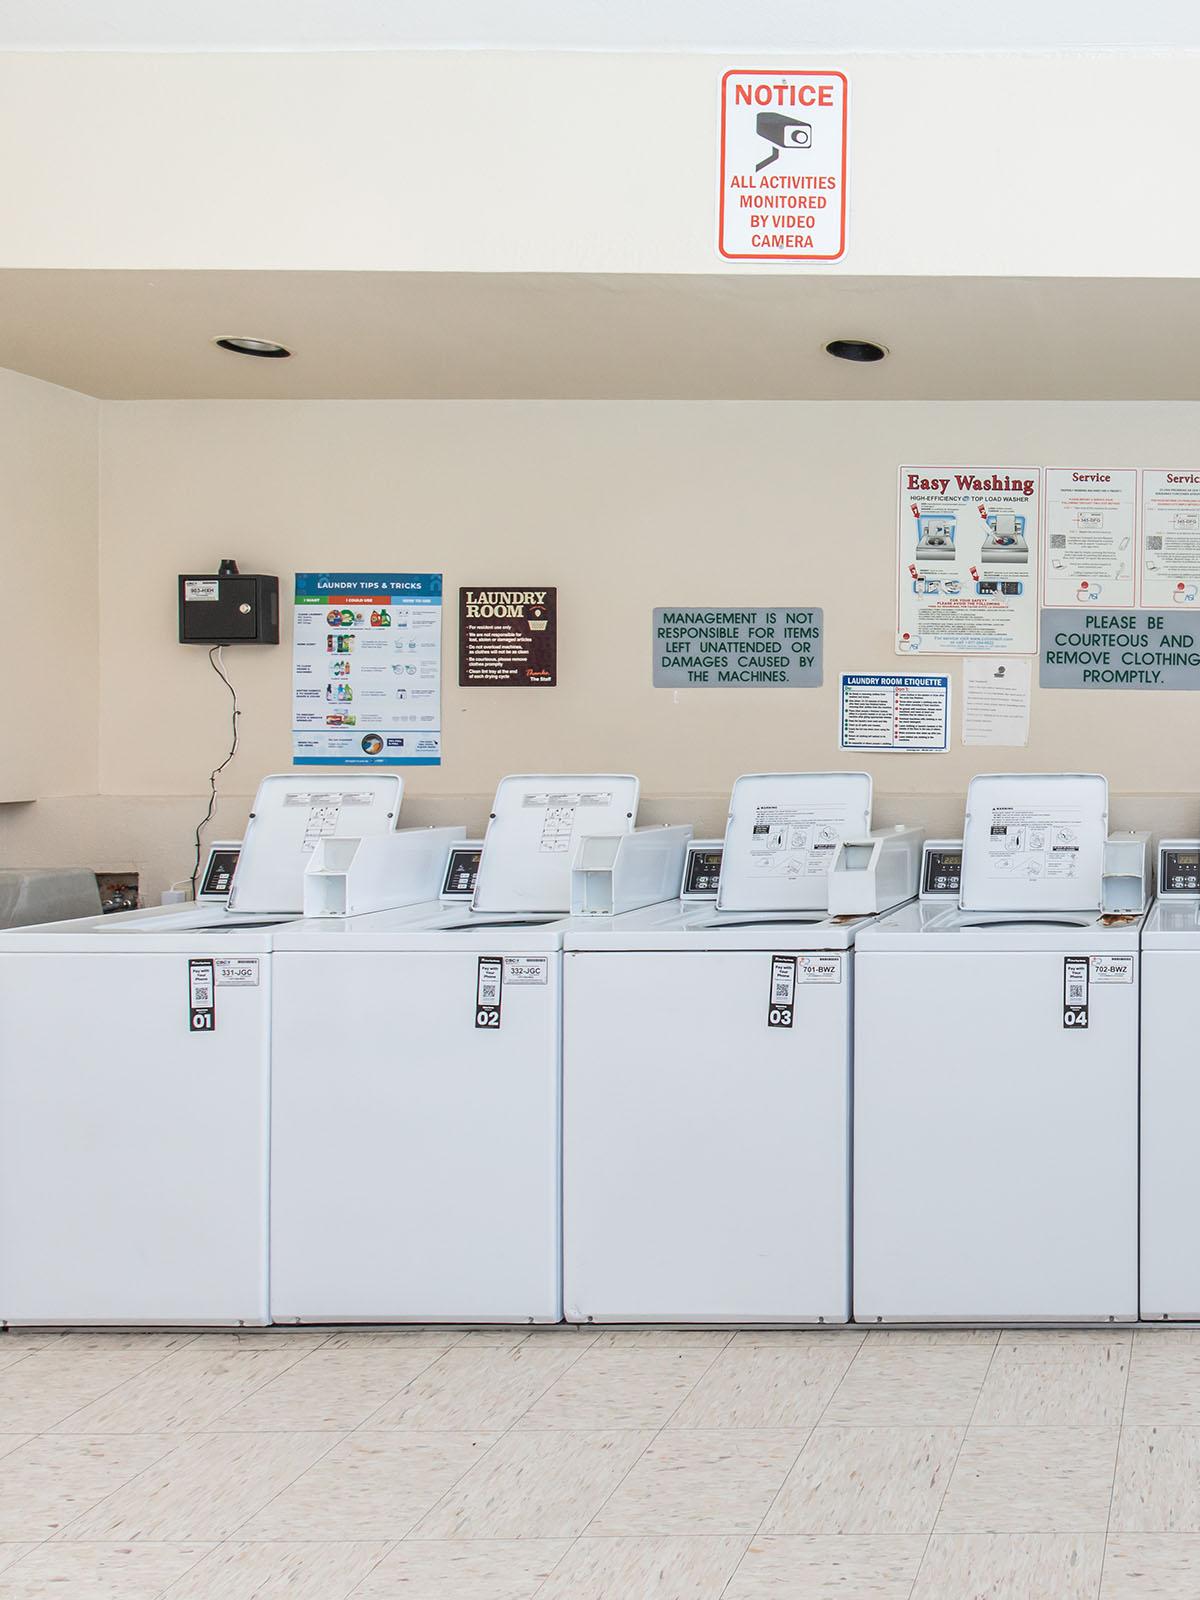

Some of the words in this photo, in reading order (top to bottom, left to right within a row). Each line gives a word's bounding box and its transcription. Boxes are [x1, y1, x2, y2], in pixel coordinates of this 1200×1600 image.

[735, 85, 834, 106] NOTICE
[731, 176, 756, 188] ALL
[760, 176, 836, 189] ACTIVITIES
[740, 195, 826, 208] MONITORED
[750, 215, 768, 227] BY
[772, 215, 815, 228] VIDEO
[752, 235, 813, 248] CAMERA
[1072, 472, 1111, 482] Service
[907, 474, 950, 495] Easy
[954, 475, 1034, 496] Washing
[466, 592, 546, 604] LAUNDRY
[466, 605, 524, 618] ROOM
[663, 613, 757, 624] MANAGEMENT
[766, 613, 776, 624] IS
[786, 613, 813, 624] NOT
[1086, 616, 1136, 629] PLEASE
[1148, 617, 1164, 629] BE
[658, 628, 739, 638] RESPONSIBLE
[749, 628, 774, 638] FOR
[784, 628, 819, 638] ITEMS
[666, 642, 690, 652] LEFT
[700, 642, 782, 652] UNATTENDED
[792, 642, 811, 652] OR
[1055, 633, 1148, 647] COURTEOUS
[1160, 635, 1194, 648] AND
[662, 657, 728, 667] DAMAGES
[738, 657, 790, 667] CAUSED
[800, 657, 814, 667] BY
[1047, 651, 1110, 664] REMOVE
[1122, 652, 1200, 666] CLOTHING
[688, 671, 708, 682] THE
[718, 671, 789, 682] MACHINES.
[1083, 670, 1164, 683] PROMPTLY.
[193, 1014, 211, 1028] 01
[477, 1011, 498, 1025] 02
[770, 1010, 791, 1025] 03
[1065, 1011, 1087, 1025] 04
